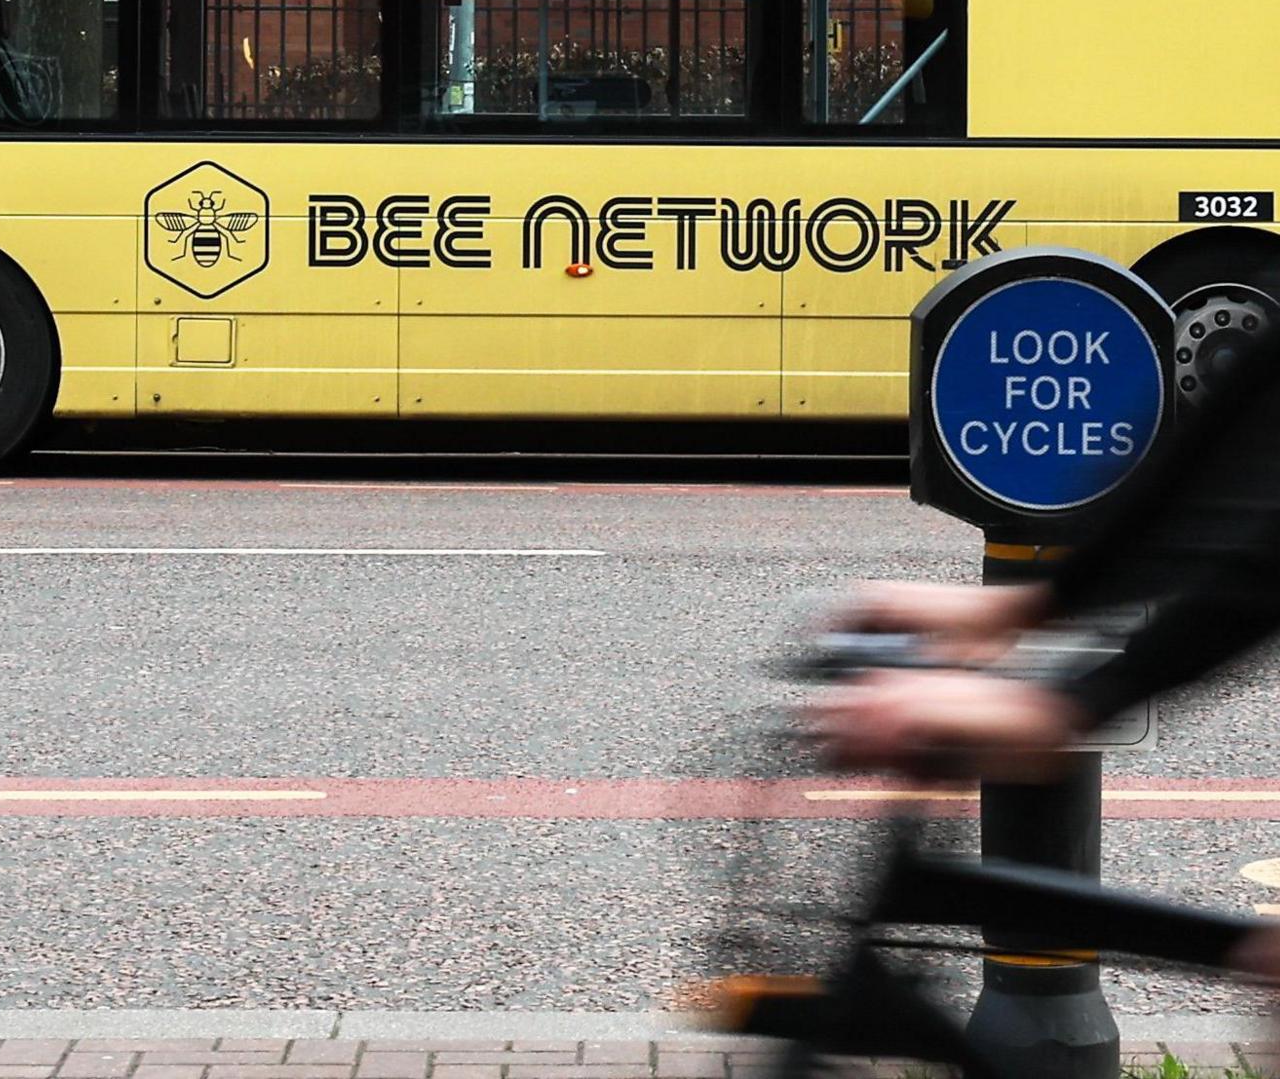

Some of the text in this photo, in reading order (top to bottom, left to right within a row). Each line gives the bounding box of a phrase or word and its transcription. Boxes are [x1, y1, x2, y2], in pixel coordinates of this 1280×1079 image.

[1194, 195, 1258, 217] 3032
[308, 193, 1017, 272] BEE NETWORK
[989, 330, 1110, 365] LOOK
[1005, 375, 1092, 410] FOR
[959, 421, 1135, 456] CYCLES
